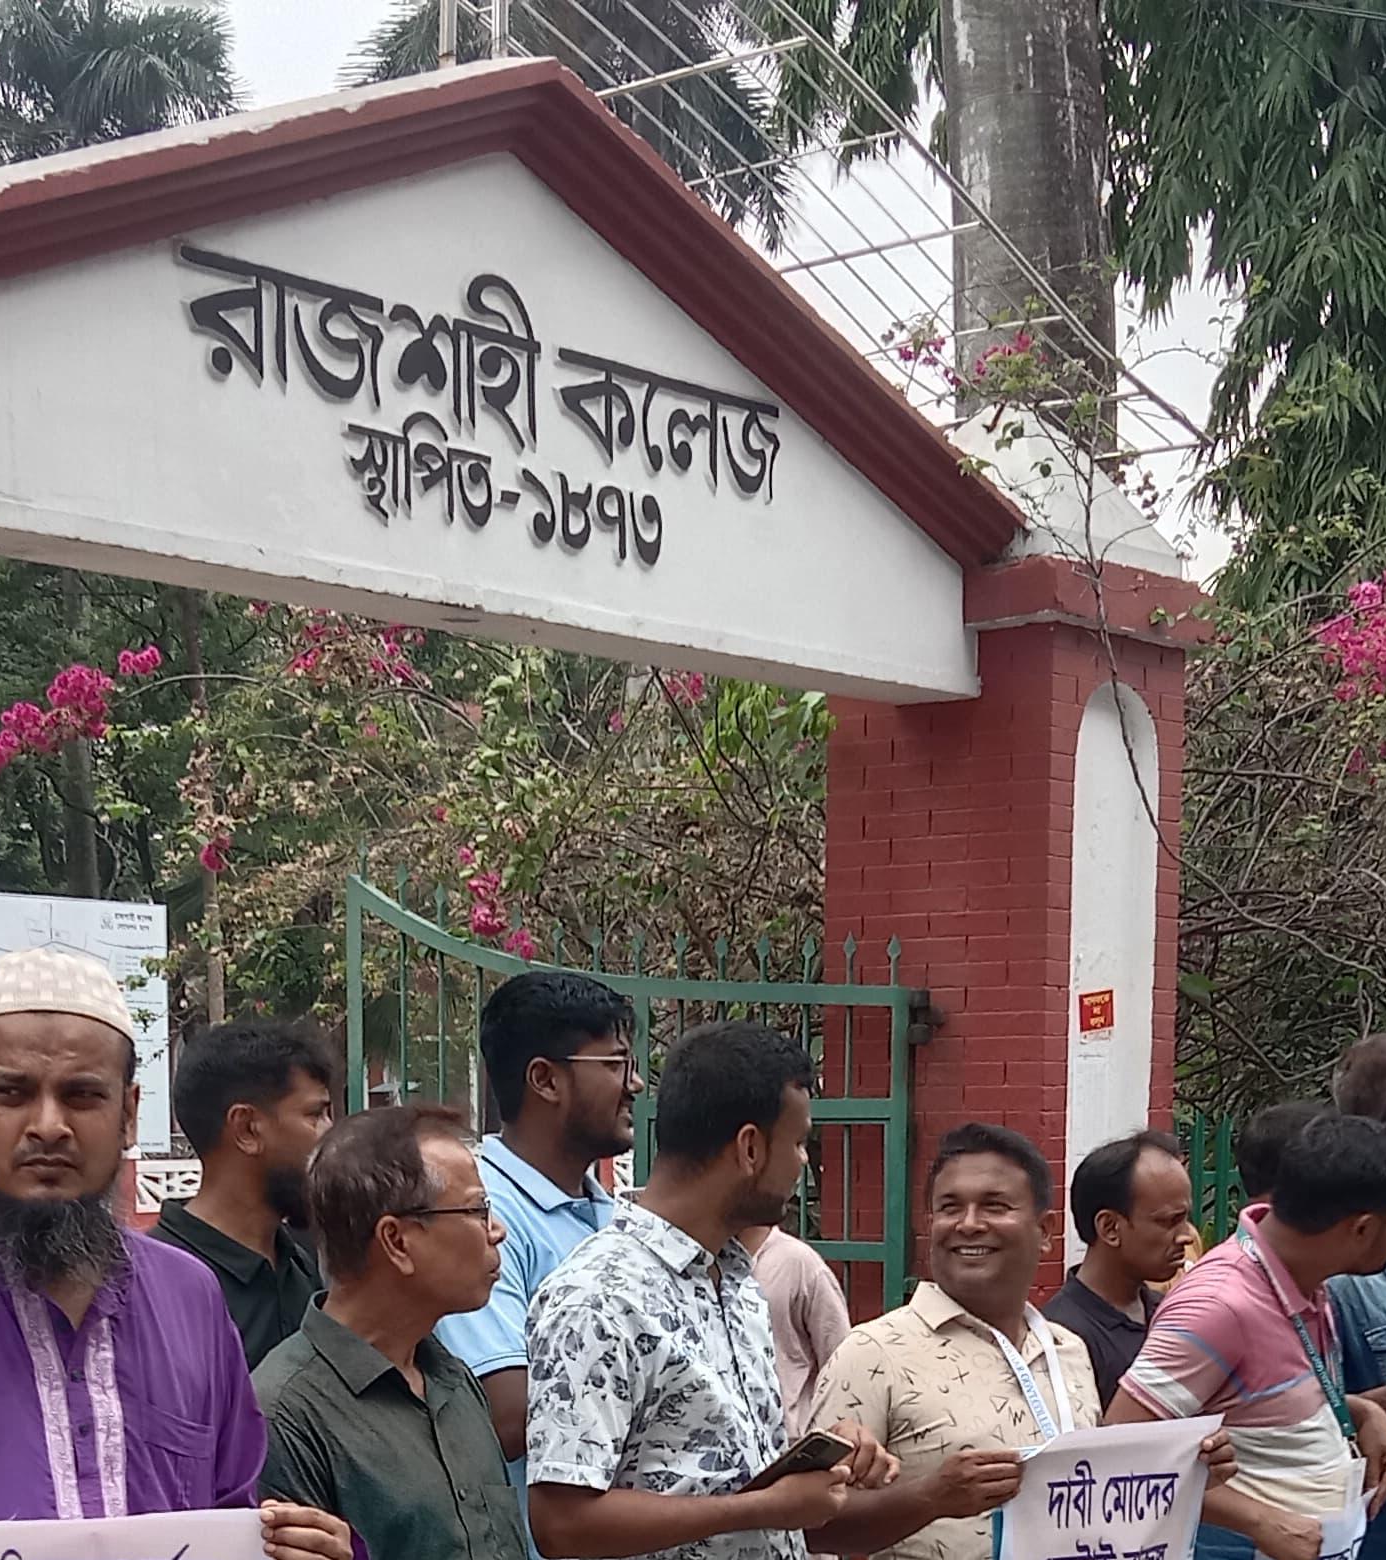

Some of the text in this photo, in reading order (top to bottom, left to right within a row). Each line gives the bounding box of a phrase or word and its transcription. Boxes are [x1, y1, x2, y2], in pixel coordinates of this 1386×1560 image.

[179, 243, 780, 503] রাজশাহী কলেজ
[1029, 1396, 1056, 1438] COLLEG
[1047, 1460, 1179, 1529] দাবী মোদের
